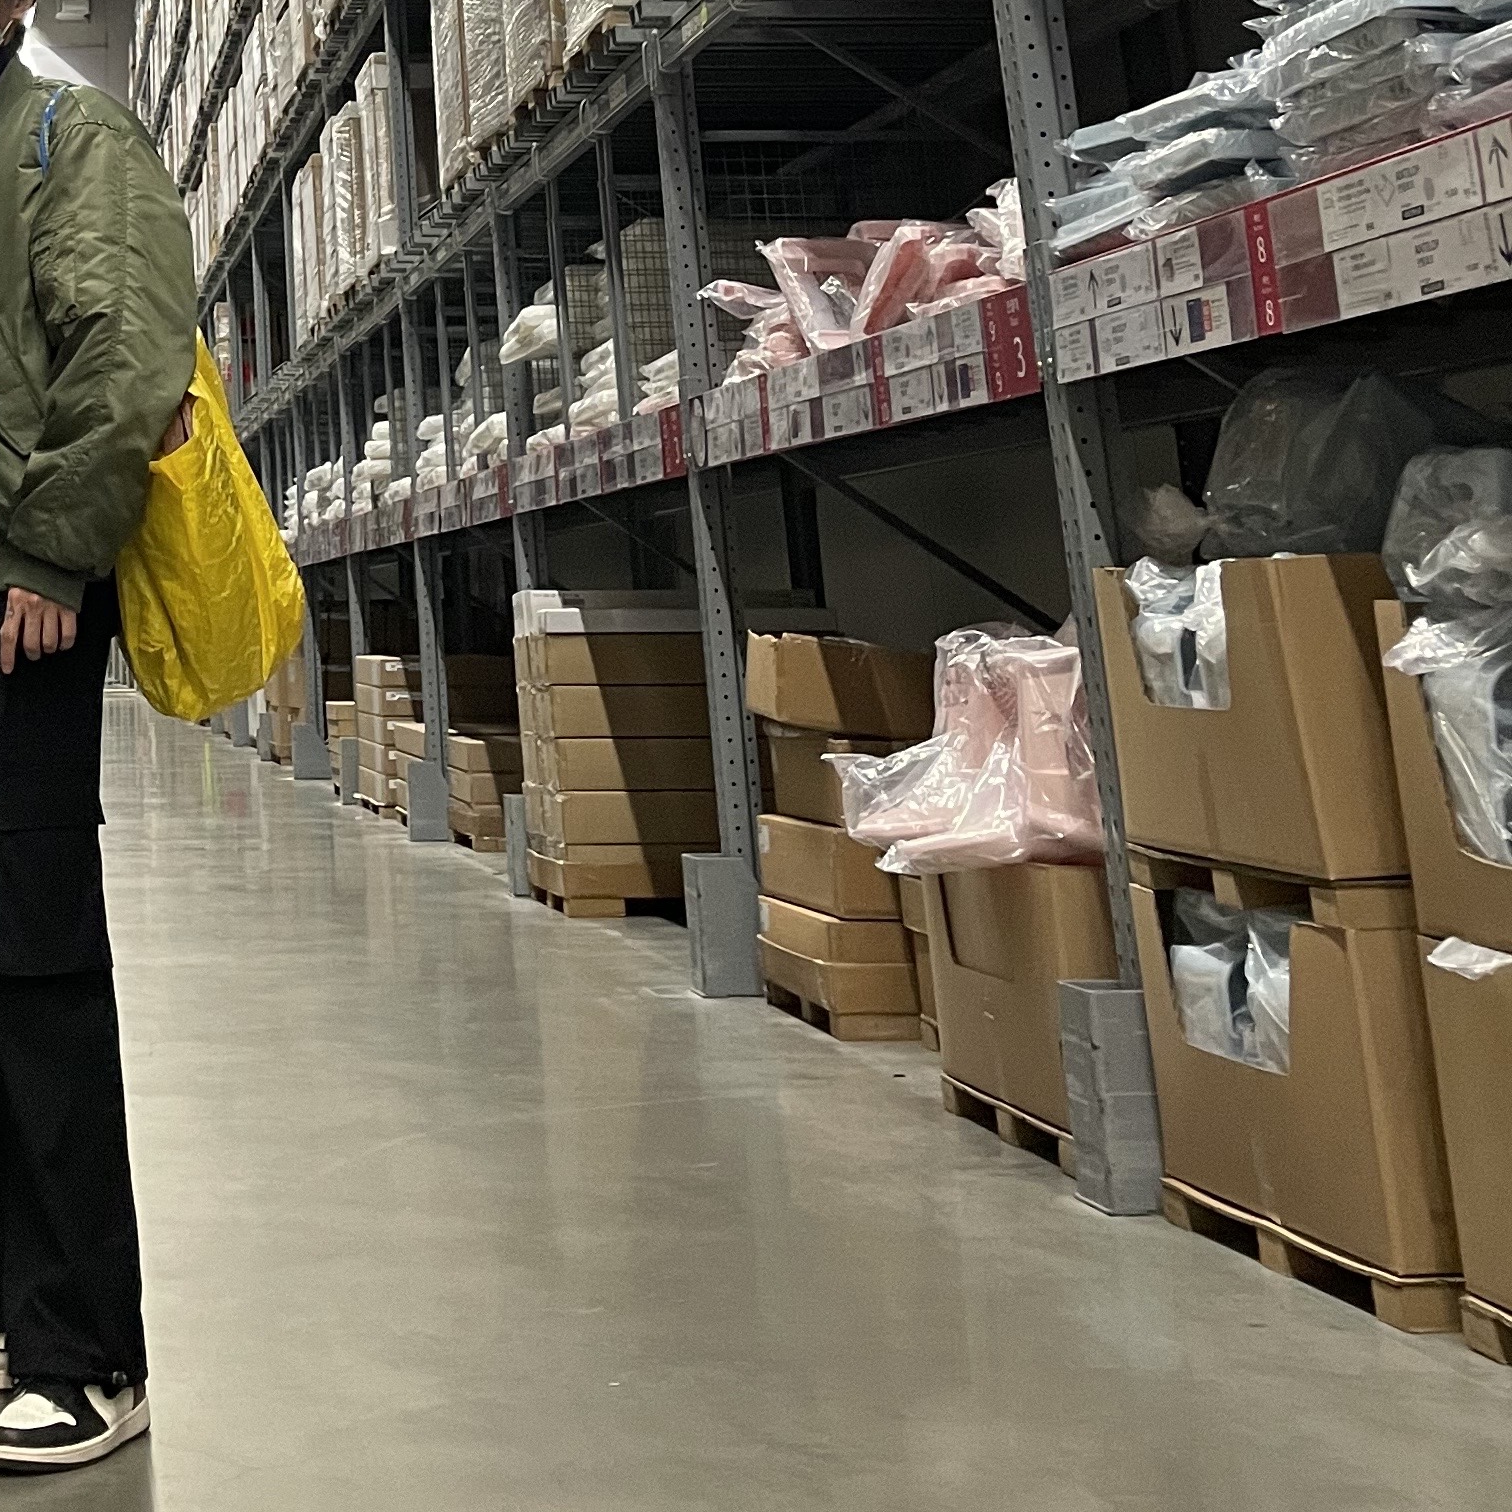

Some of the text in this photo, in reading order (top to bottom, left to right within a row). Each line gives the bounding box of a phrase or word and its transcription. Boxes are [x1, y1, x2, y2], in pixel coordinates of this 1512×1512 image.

[1256, 236, 1267, 263] 8
[1265, 299, 1275, 326] 8
[1013, 336, 1026, 378] 3
